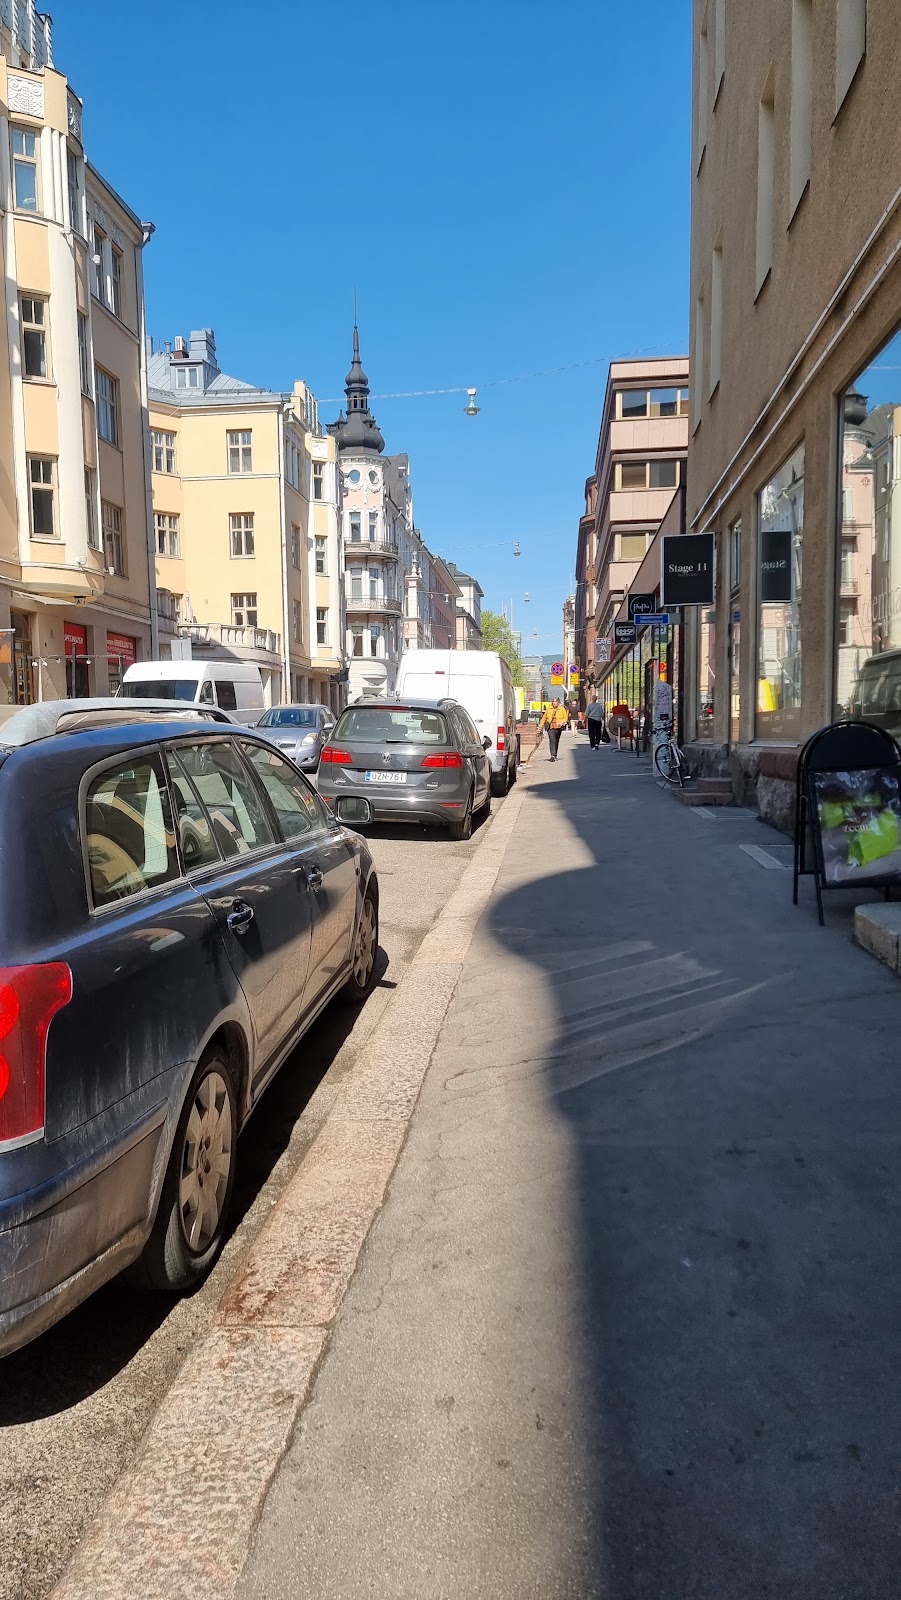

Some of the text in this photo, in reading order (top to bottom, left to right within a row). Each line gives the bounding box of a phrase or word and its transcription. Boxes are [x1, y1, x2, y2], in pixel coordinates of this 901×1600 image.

[668, 562, 708, 574] Stage 11
[371, 772, 404, 781] UZN-761
